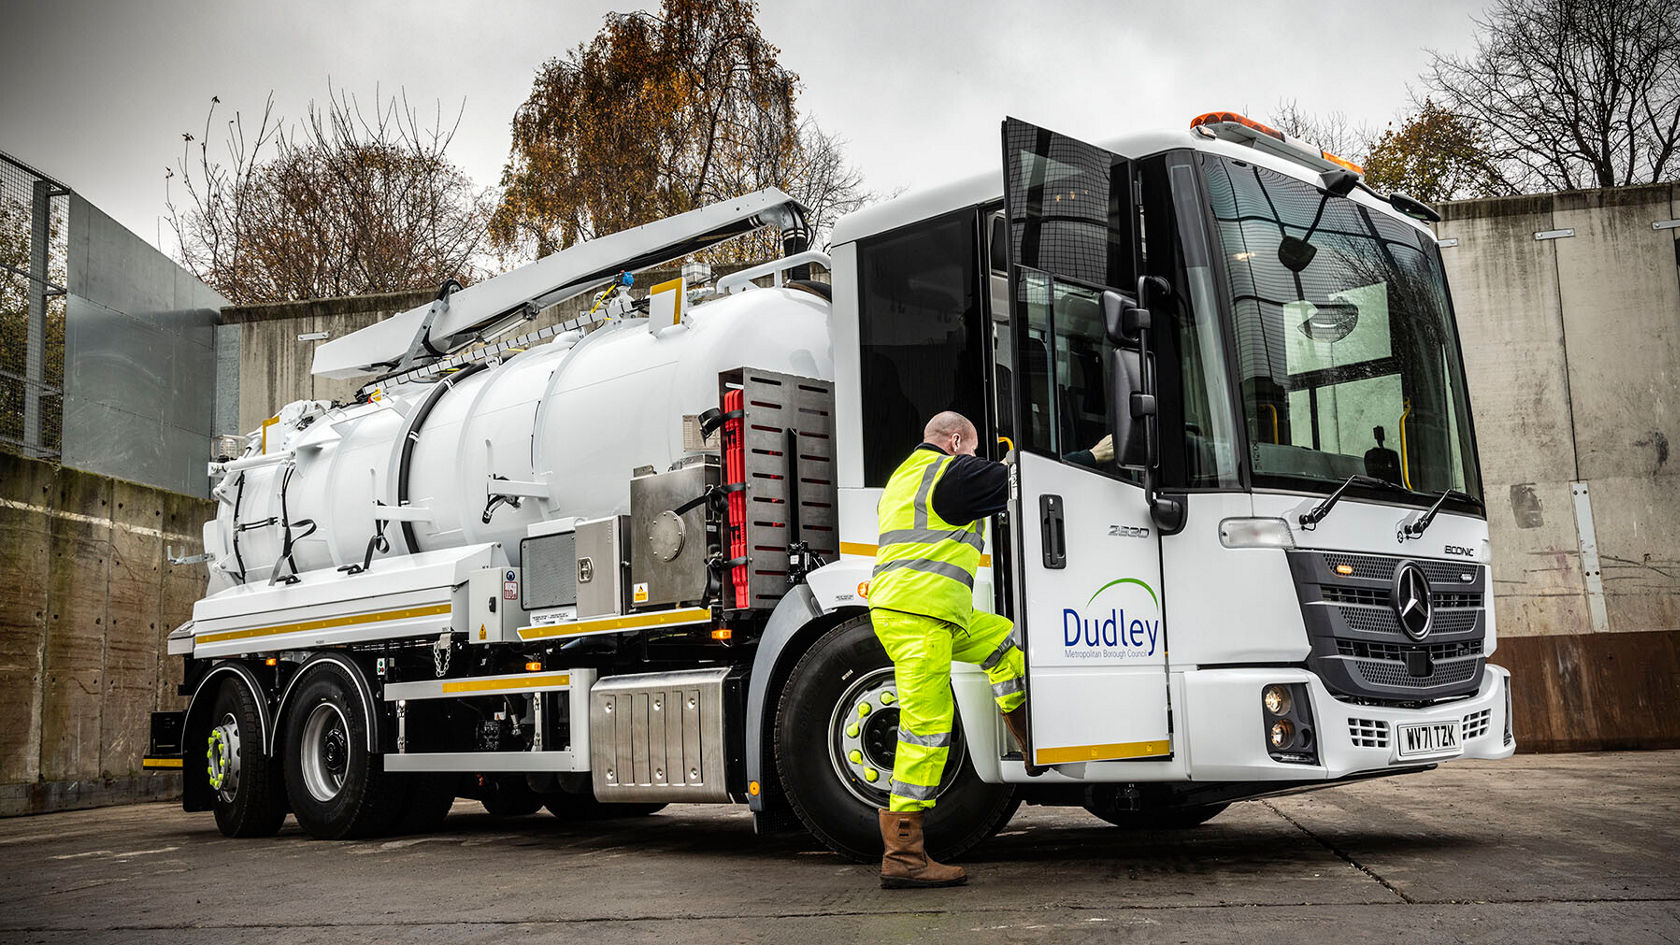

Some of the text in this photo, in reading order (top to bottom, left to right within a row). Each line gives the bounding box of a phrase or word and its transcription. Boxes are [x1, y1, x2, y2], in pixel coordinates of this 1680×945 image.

[1444, 545, 1475, 557] ECONIC
[1063, 608, 1159, 656] Dudley
[1064, 649, 1147, 659] Metropolitan Borough Council
[1406, 724, 1456, 750] WV71 TZK
